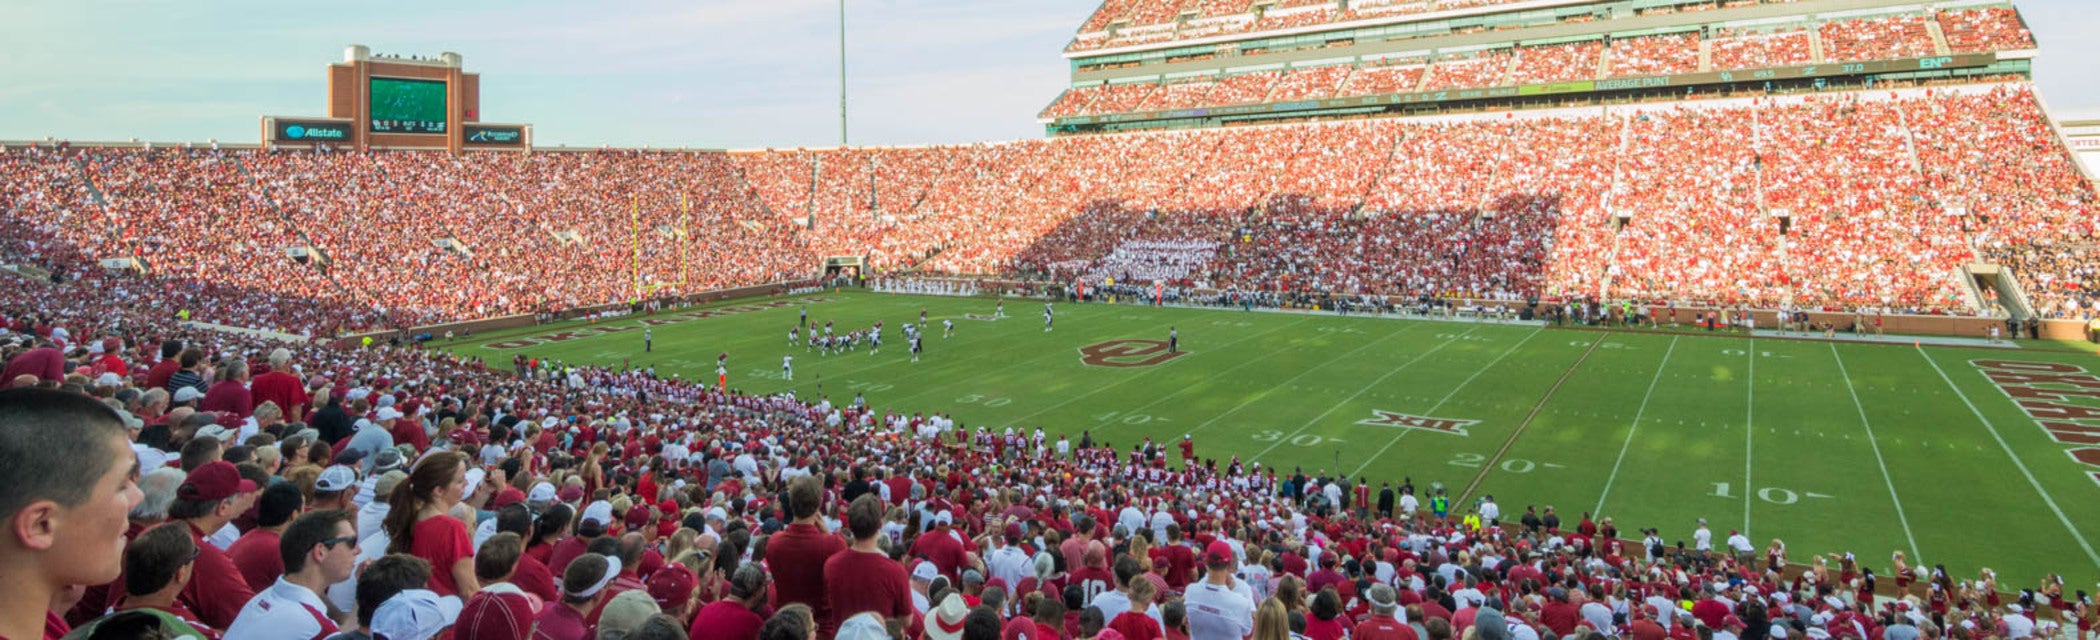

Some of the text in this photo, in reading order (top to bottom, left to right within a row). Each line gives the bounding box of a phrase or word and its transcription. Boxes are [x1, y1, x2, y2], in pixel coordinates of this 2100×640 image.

[1596, 76, 1670, 90] AVERAGE PUNT
[304, 128, 343, 138] Allstate
[1448, 452, 1536, 474] 20
[1706, 482, 1799, 505] 10
